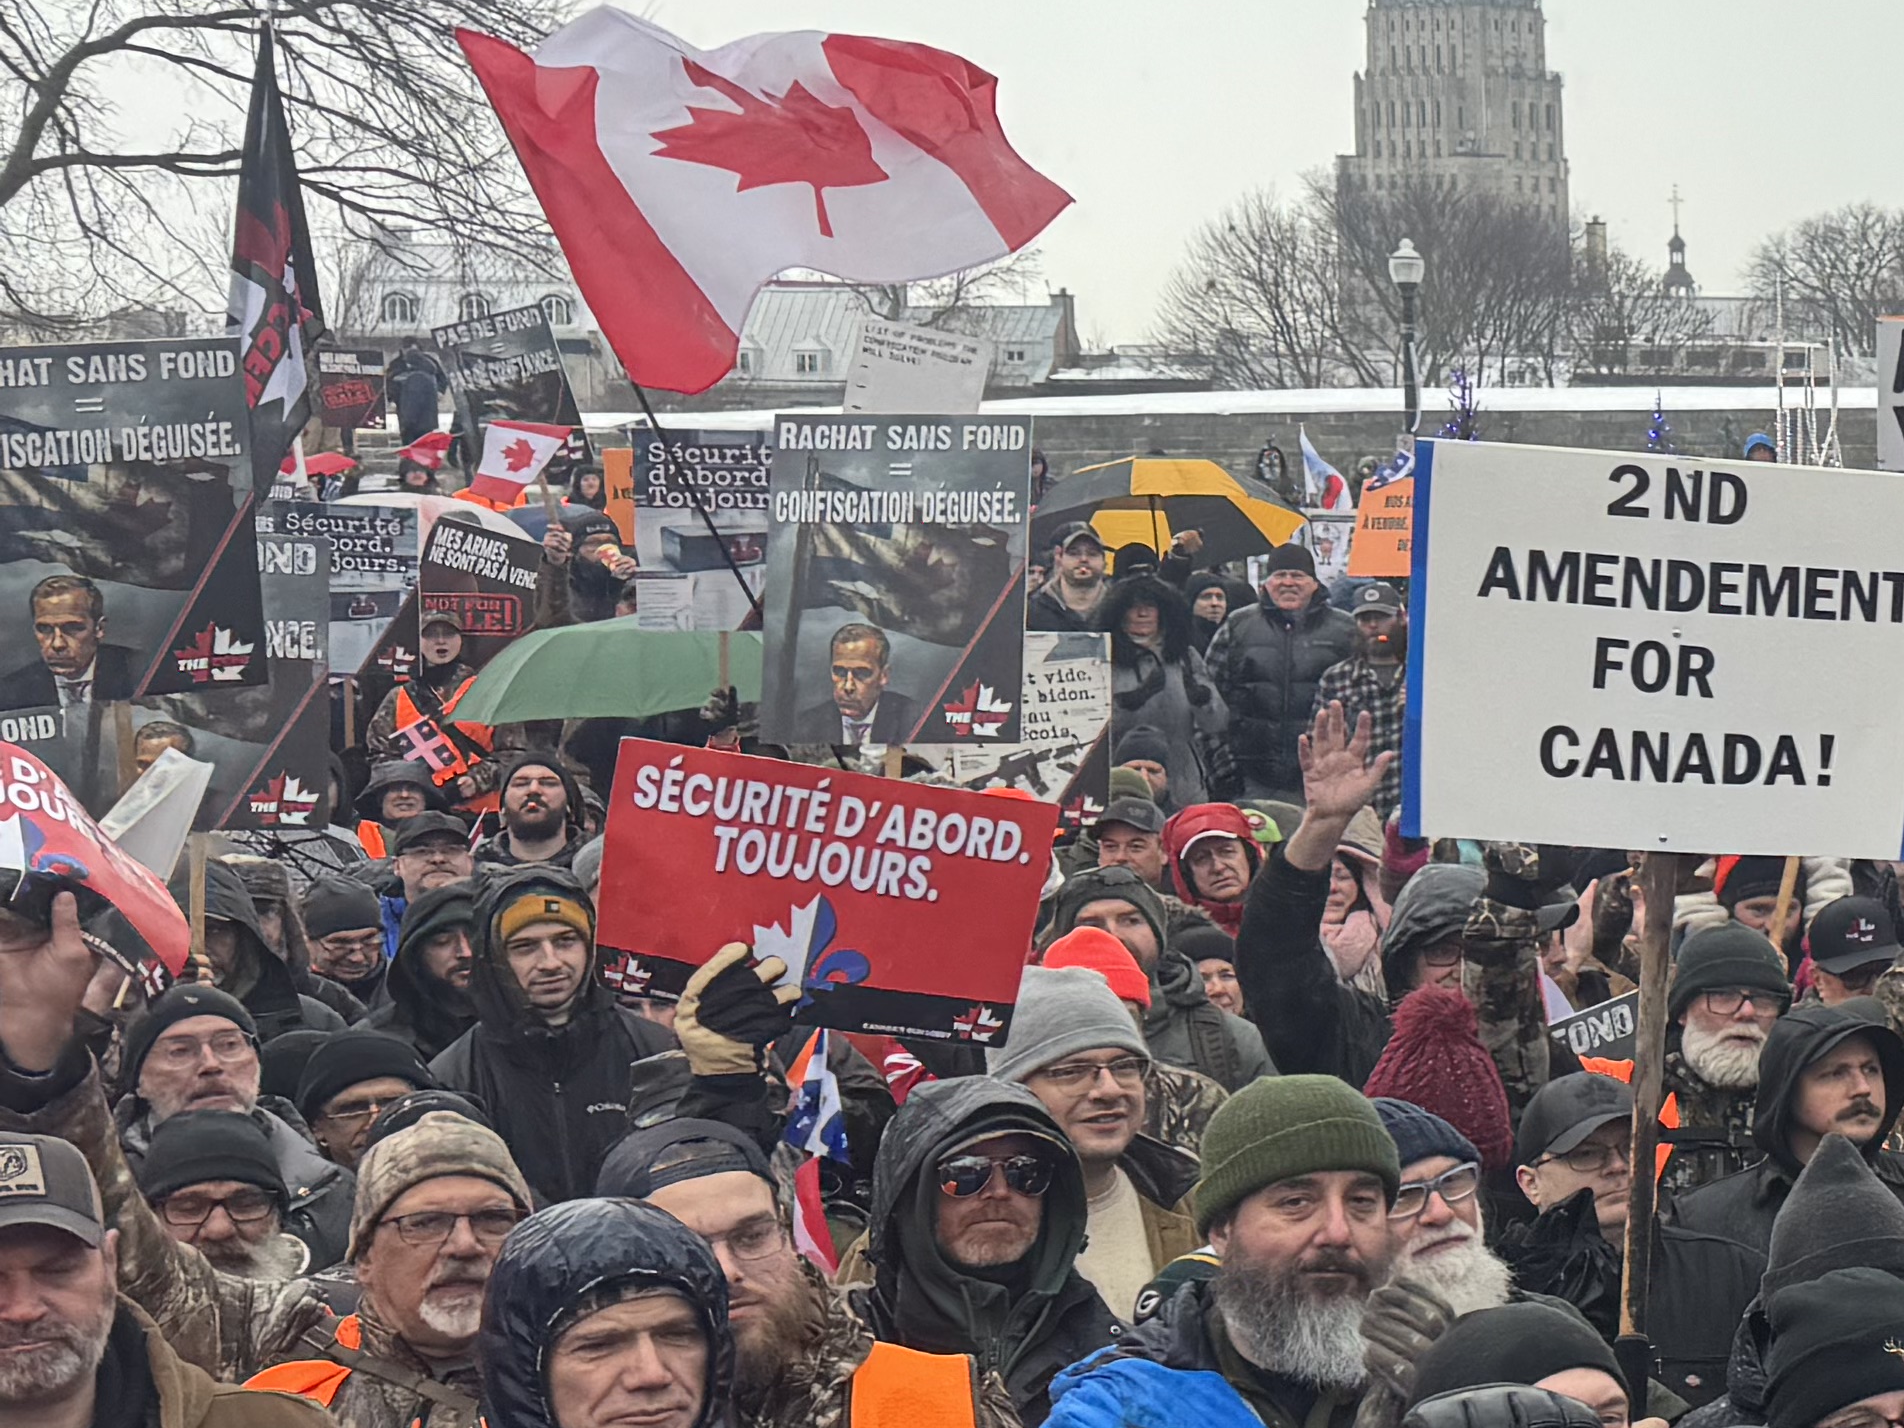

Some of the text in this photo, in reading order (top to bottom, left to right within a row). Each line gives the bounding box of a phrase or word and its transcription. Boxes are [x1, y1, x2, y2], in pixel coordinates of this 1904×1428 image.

[67, 349, 236, 384] SANS FOND
[3, 410, 242, 469] ISCATION DÉGUISÉE.
[779, 422, 1026, 450] RACHAT SANS FOND
[775, 481, 1021, 525] CONFISCATION DÉGUISÉE.
[1607, 464, 1749, 526] 2ND
[286, 513, 403, 536] Sécurité
[434, 524, 463, 551] MES
[1593, 638, 1715, 699] FOR
[1038, 687, 1096, 705] bidon.
[1539, 726, 1835, 787] CANADA!
[633, 754, 1030, 864] SÉCURITÉ D'ABORD.
[714, 825, 938, 903] TOUJOURS.
